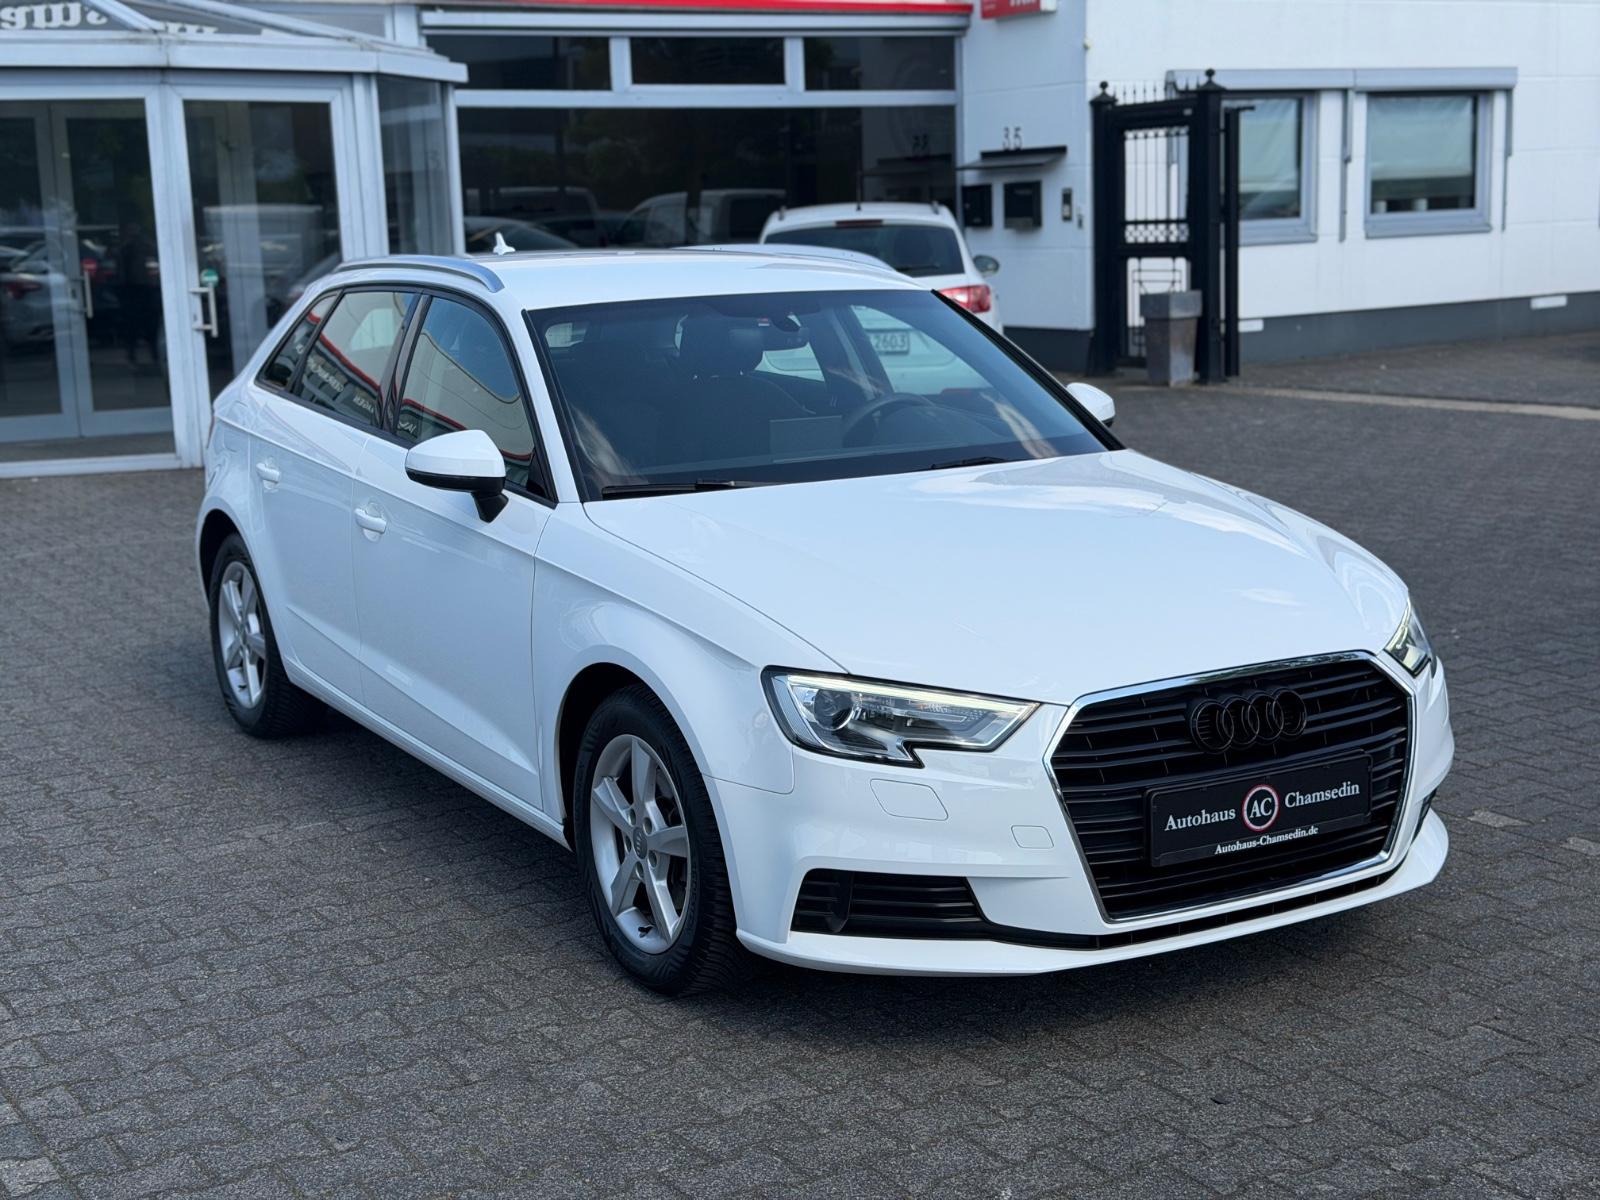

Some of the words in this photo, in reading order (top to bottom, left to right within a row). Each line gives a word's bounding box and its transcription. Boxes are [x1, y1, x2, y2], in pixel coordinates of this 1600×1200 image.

[1003, 126, 1022, 150] 35
[1164, 808, 1236, 831] Autohaus
[1249, 798, 1272, 818] AC
[1284, 781, 1360, 808] Chamsedin
[1214, 825, 1319, 855] Autohaus-Chamsedin.de
